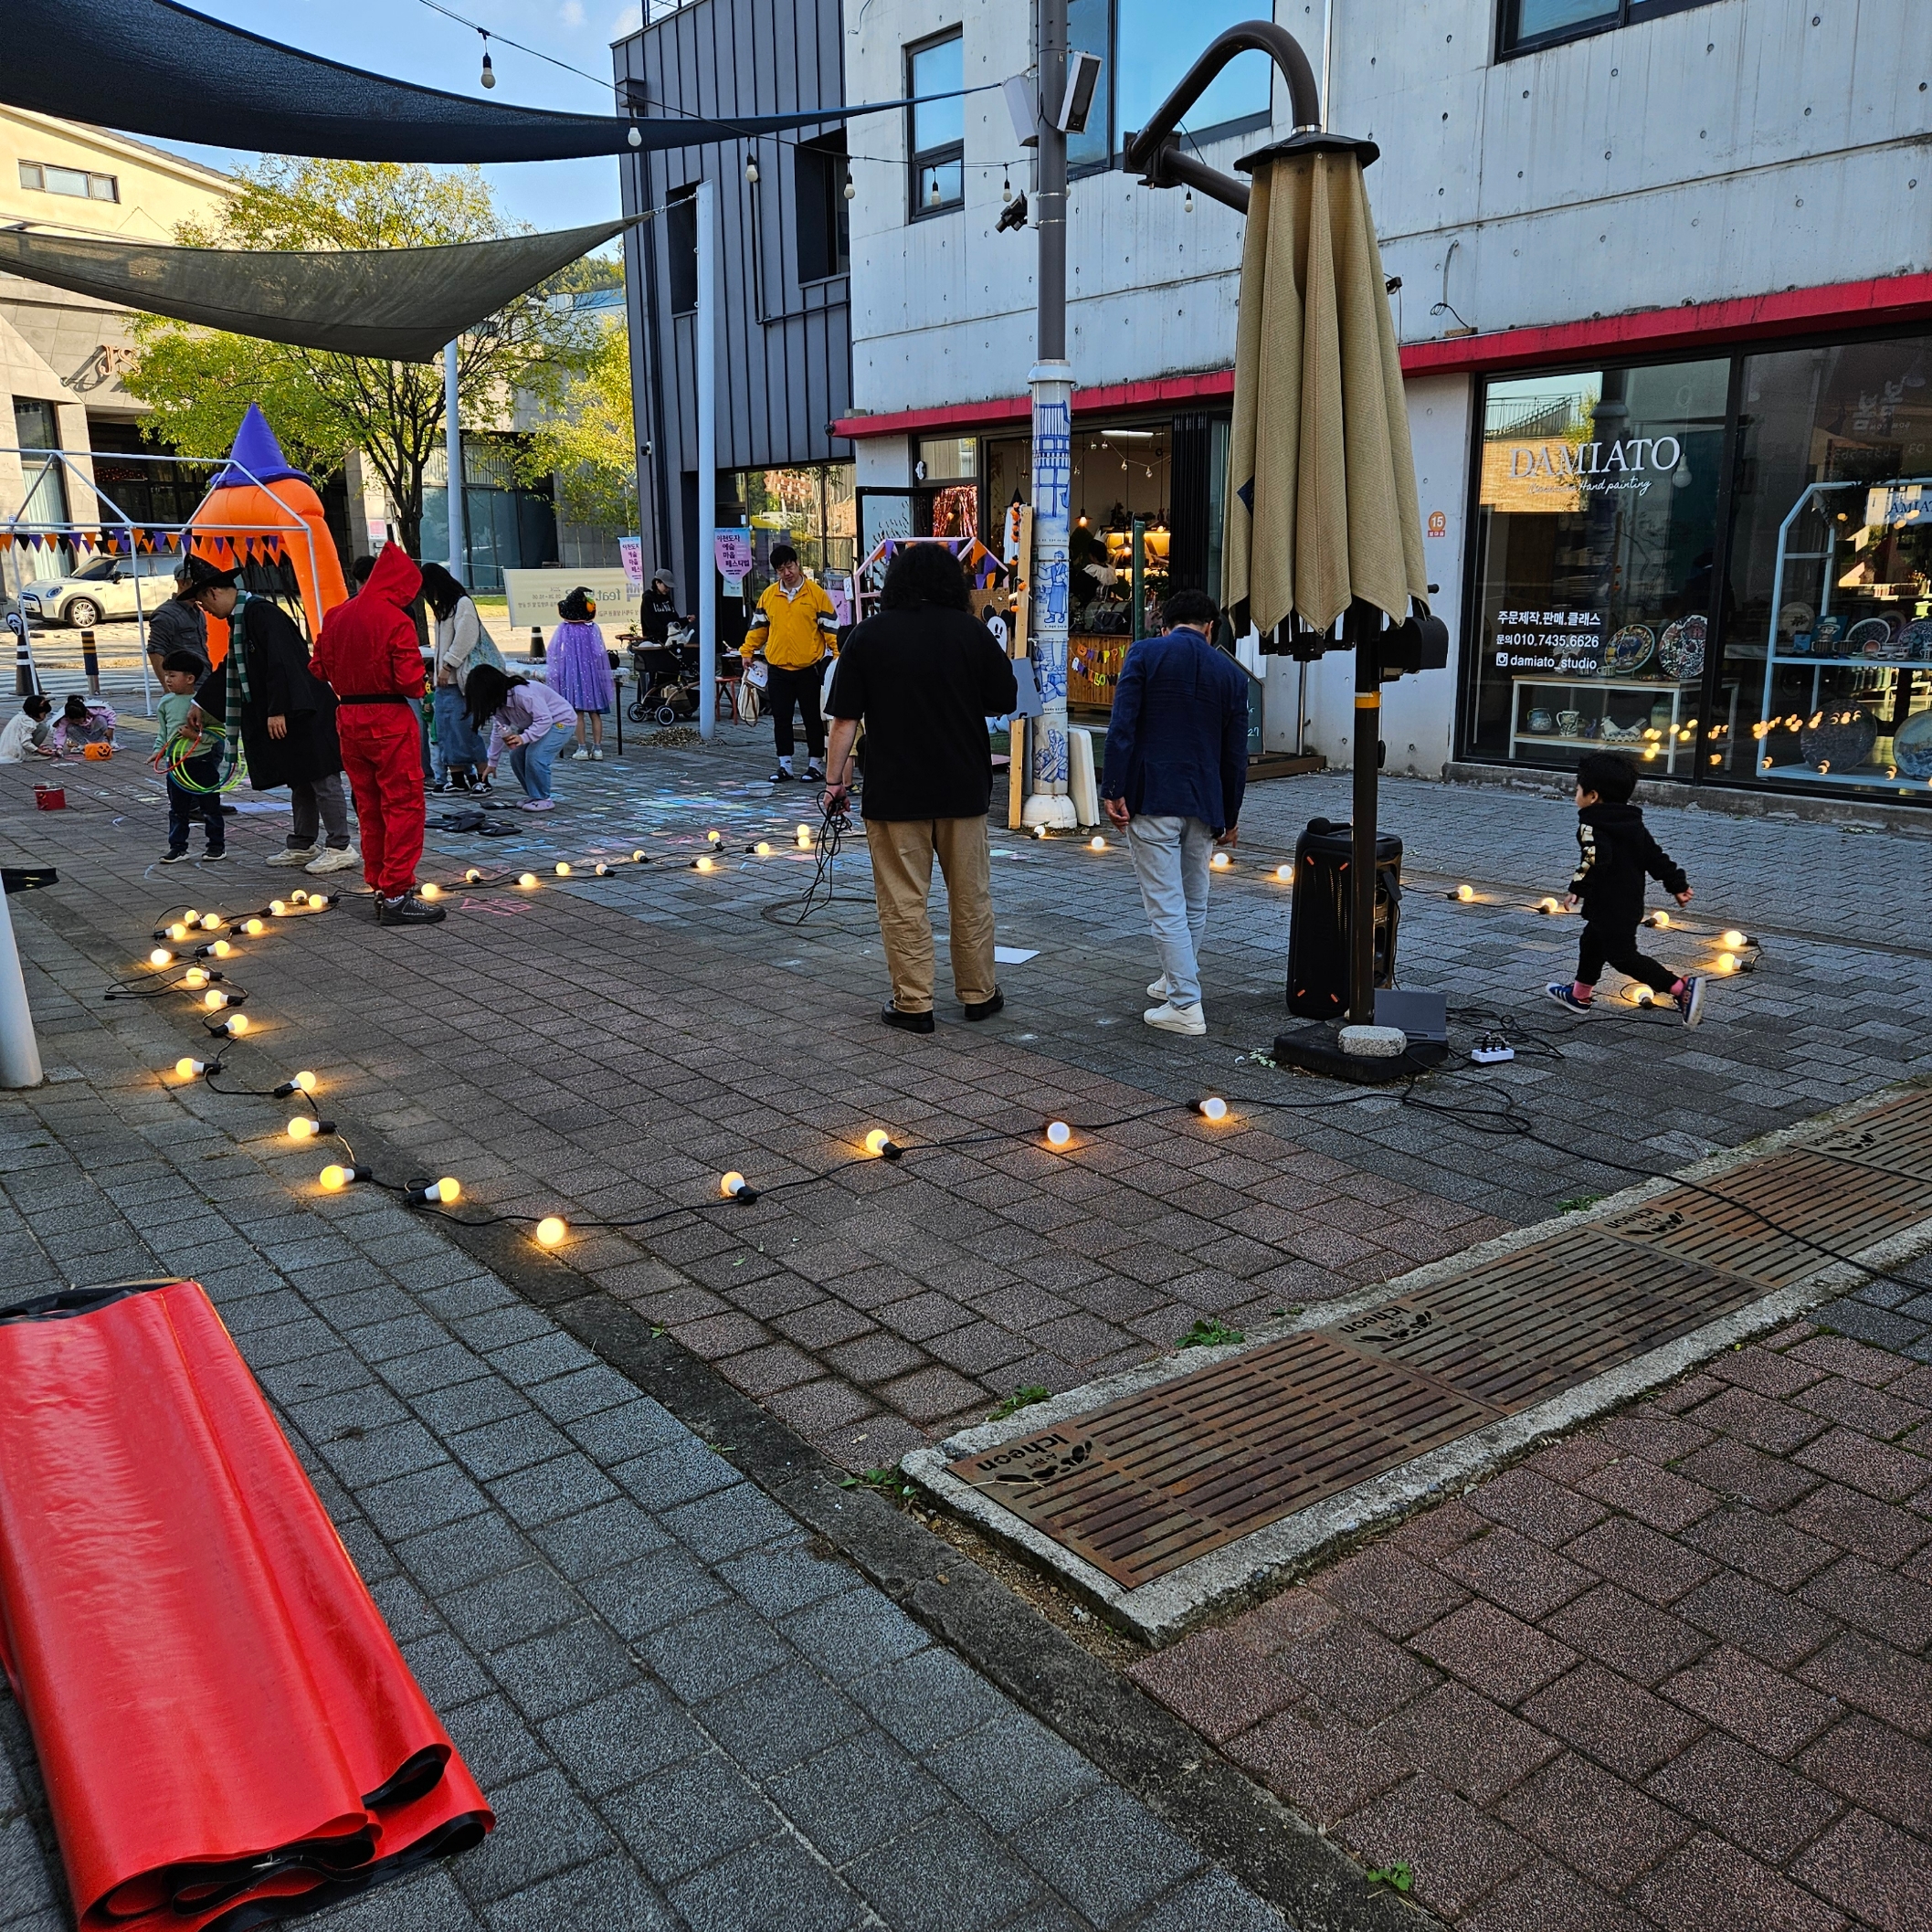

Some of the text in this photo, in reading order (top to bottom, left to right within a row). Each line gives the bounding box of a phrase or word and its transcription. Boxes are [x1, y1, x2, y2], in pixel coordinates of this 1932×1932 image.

[1508, 437, 1681, 479] DAMIATO
[1578, 479, 1606, 491] Hand
[1605, 475, 1652, 496] painting
[1431, 516, 1443, 527] 15
[716, 534, 741, 543] 이천도자
[722, 543, 735, 551] 예술
[725, 559, 750, 567] 페스티벌
[1086, 644, 1126, 664] HAPPY
[1510, 655, 1598, 670] damiato_studio
[1077, 660, 1122, 687] HALLOW
[1337, 1305, 1412, 1334] Icheon
[975, 1432, 1071, 1472] Icheon
